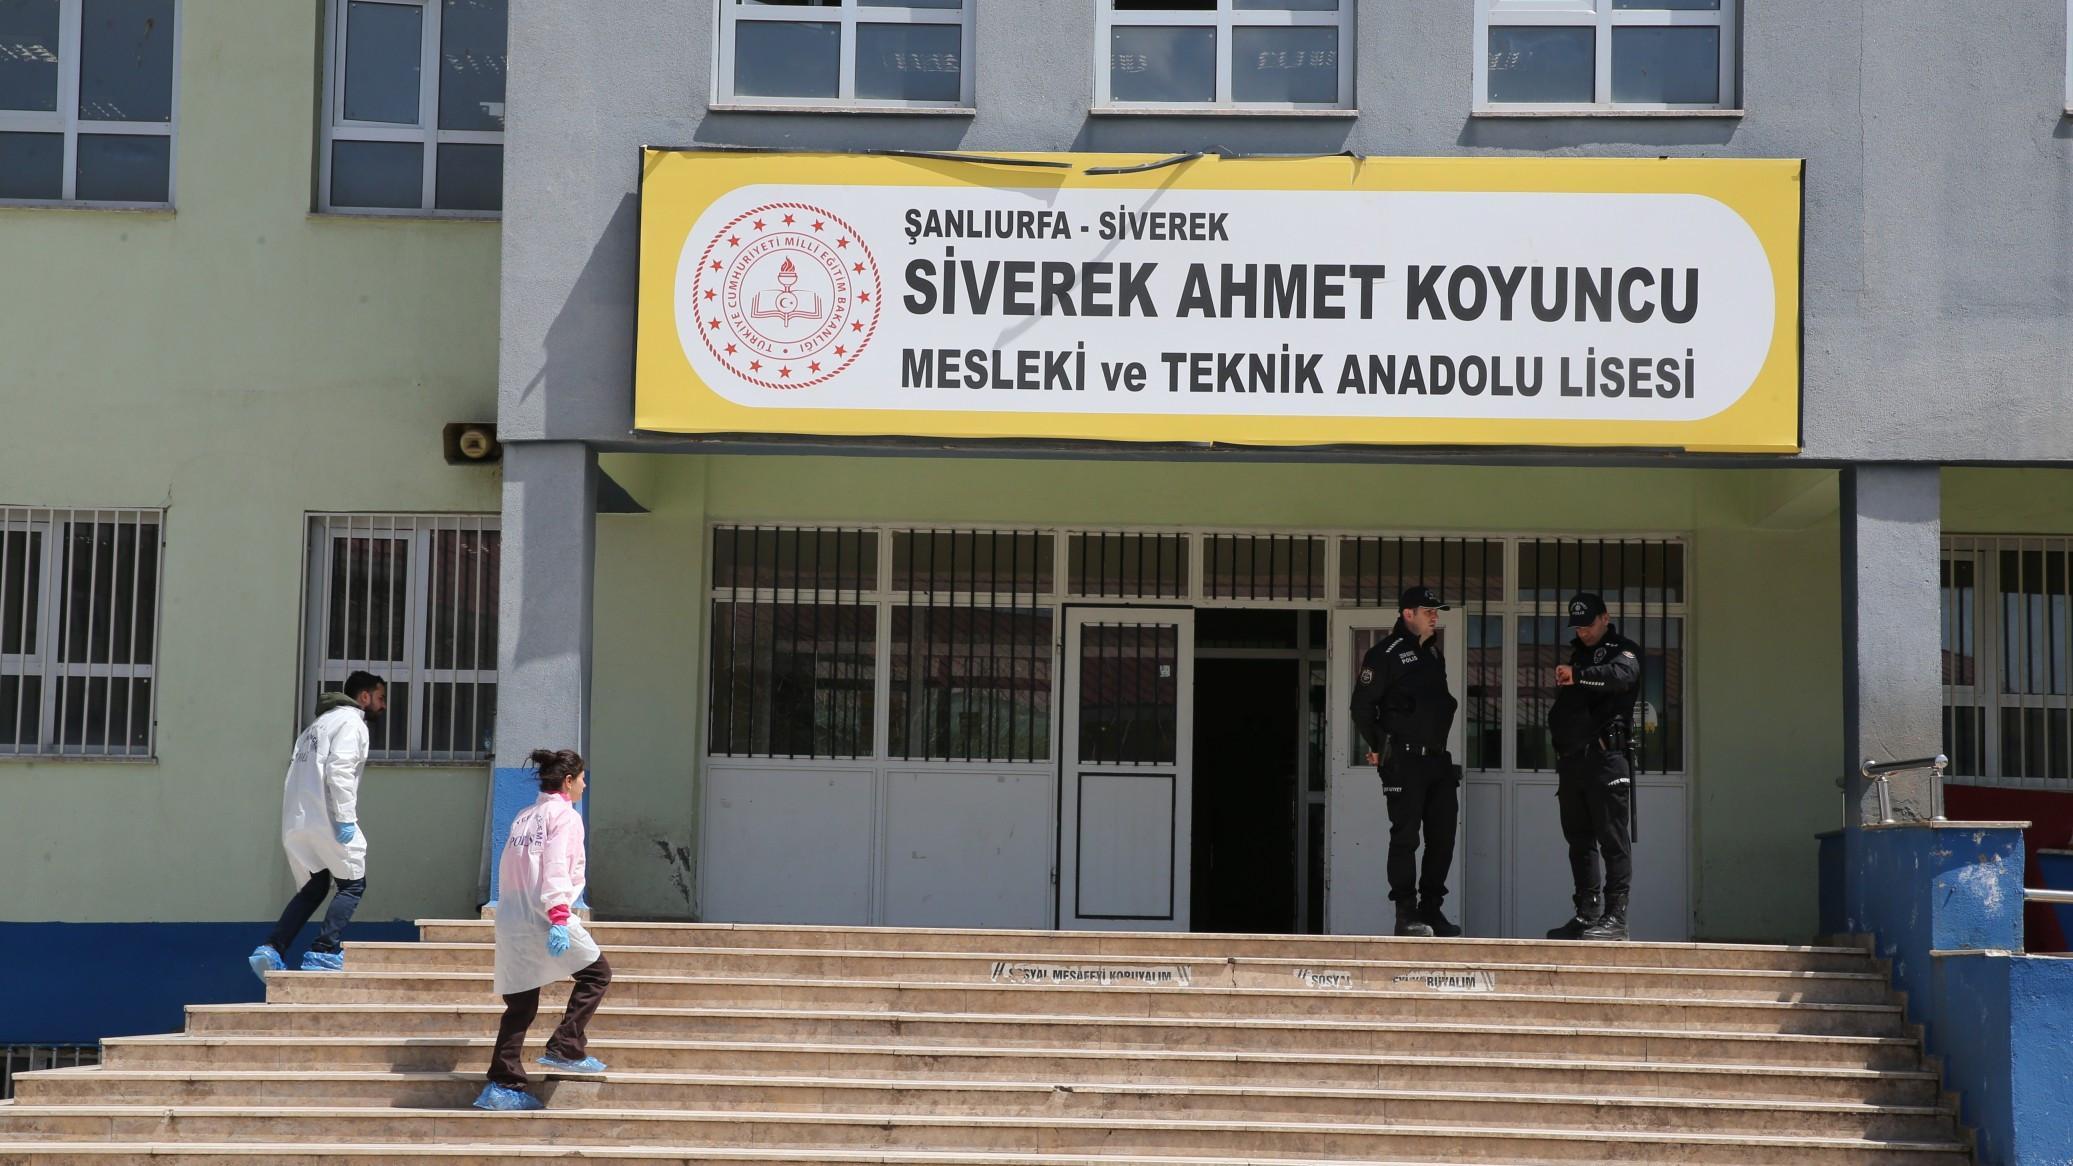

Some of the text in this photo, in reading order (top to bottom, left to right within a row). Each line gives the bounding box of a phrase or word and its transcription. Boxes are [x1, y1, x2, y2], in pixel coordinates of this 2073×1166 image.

[905, 208, 1071, 246] ŞANLIURFA
[1098, 203, 1229, 241] SİVEREK
[727, 236, 847, 353] TÜRKİYE CUMHURİYETİ MİLLİ EĞİTİM BAKANLIĞI
[904, 246, 1699, 324] SİVEREK AHMET KOYUNCU
[902, 340, 1695, 398] MESLEKİ ve TEKNİK ANADOLU LİSESİ
